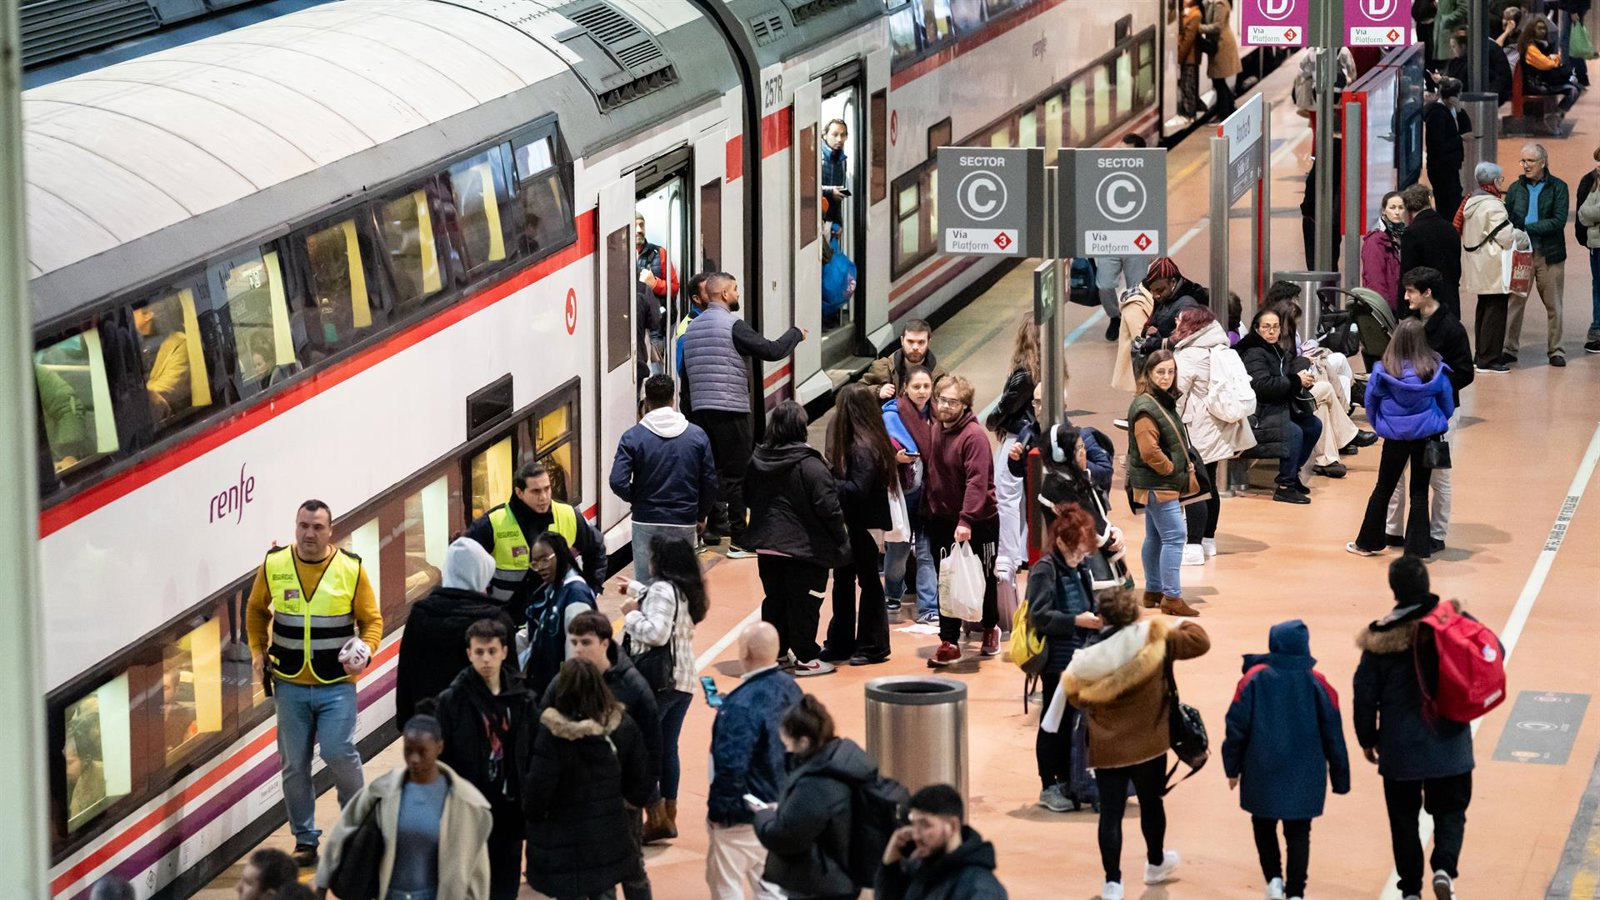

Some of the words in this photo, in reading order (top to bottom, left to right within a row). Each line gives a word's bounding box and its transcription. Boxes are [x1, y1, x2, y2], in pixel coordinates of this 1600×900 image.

[1252, 35, 1280, 43] Platform
[1287, 31, 1293, 39] 3
[1355, 36, 1383, 44] Platform
[1389, 31, 1397, 39] 4
[959, 156, 1005, 167] SECTOR
[1097, 157, 1144, 168] SECTOR
[967, 178, 997, 213] C
[1106, 179, 1136, 214] C
[952, 240, 989, 251] Platform
[999, 235, 1007, 247] 3
[1138, 236, 1147, 248] 4
[1091, 243, 1129, 254] Platform
[209, 462, 255, 525] renfe
